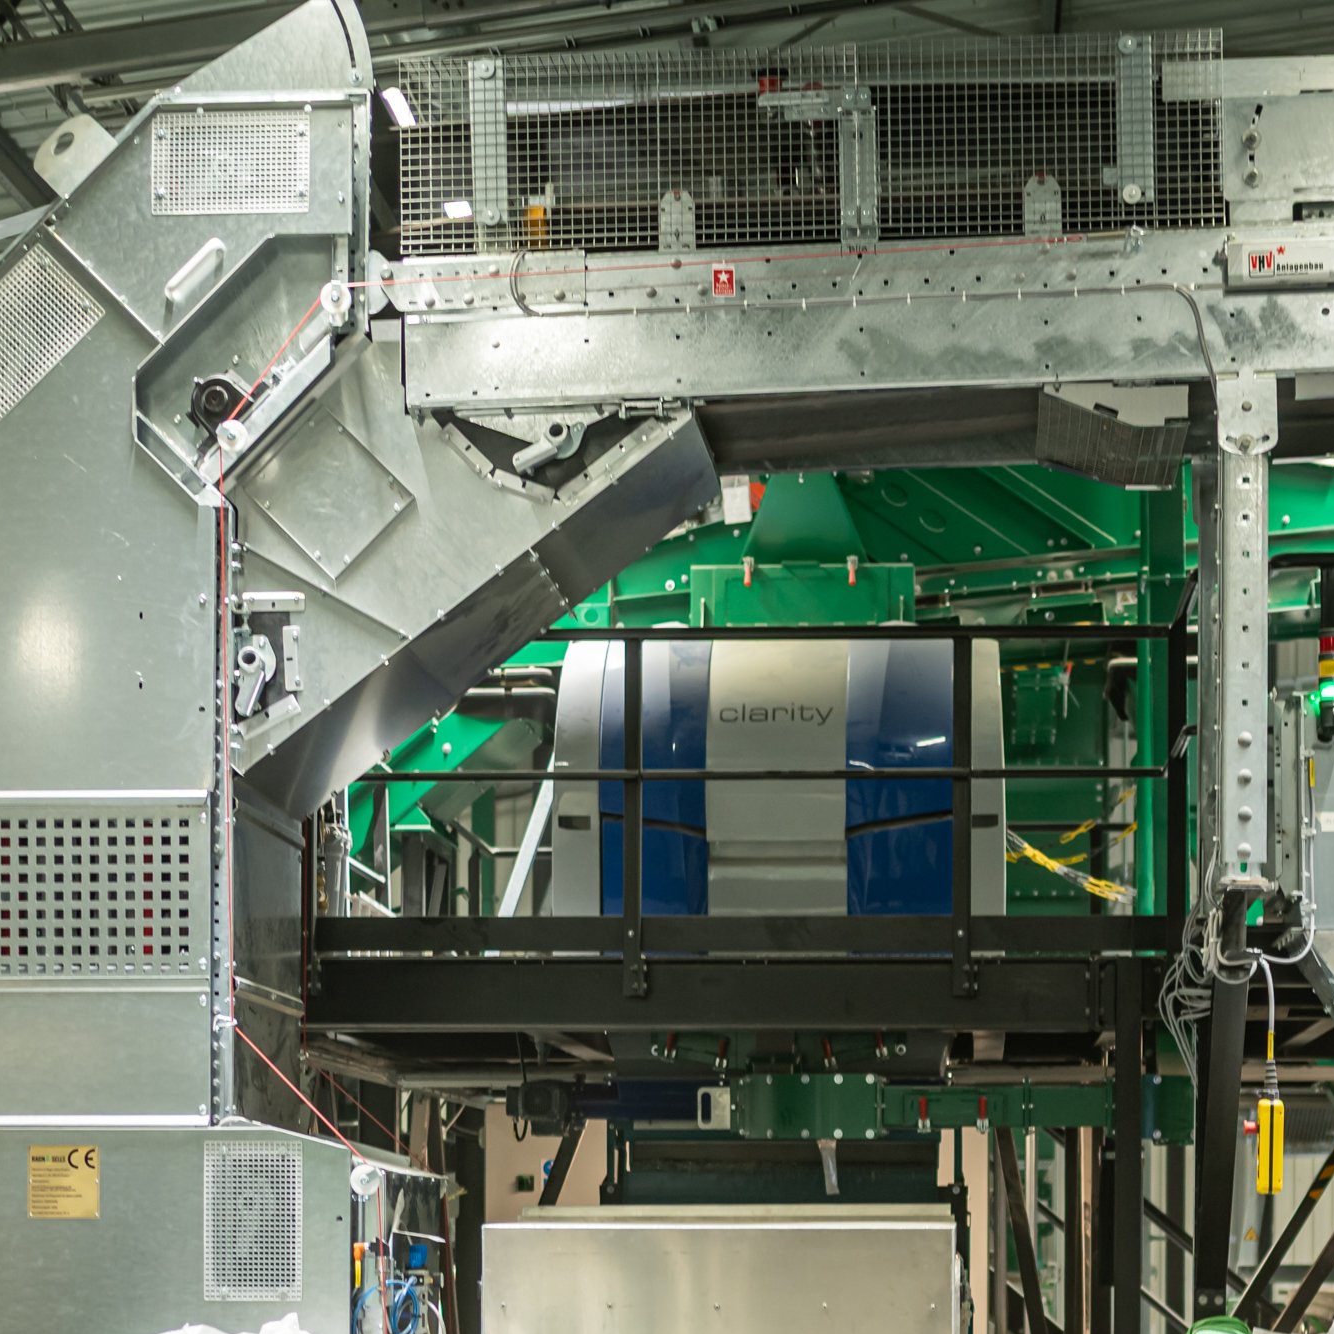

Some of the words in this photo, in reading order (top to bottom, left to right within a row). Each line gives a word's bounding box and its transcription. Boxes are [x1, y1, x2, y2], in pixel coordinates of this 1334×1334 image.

[1250, 251, 1273, 273] VHV
[1276, 262, 1324, 273] Anlagenbau
[719, 702, 833, 726] clarity
